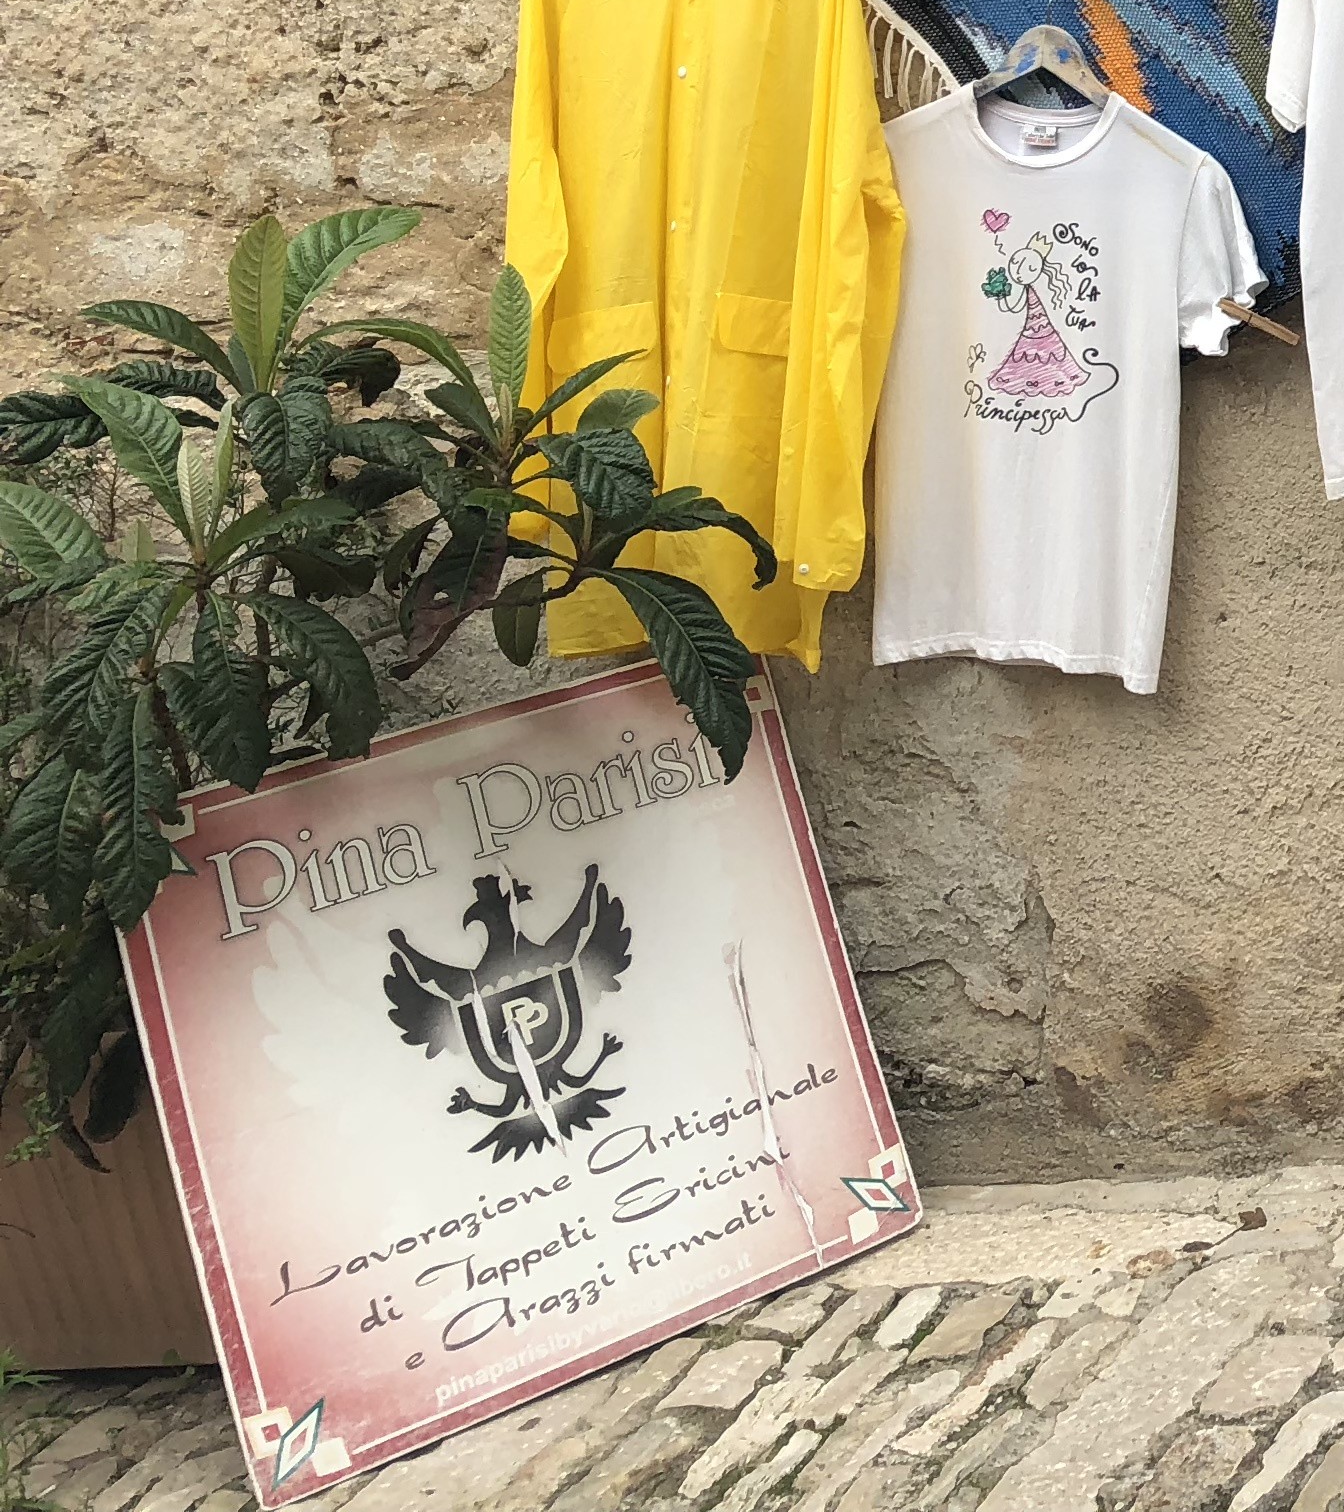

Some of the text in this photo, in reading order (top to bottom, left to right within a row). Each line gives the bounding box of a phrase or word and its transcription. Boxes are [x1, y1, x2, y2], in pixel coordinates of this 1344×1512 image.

[207, 711, 720, 942] Pina Parisi
[271, 1062, 839, 1306] Lavorazione Artigianale
[359, 1145, 791, 1335] di Tappeti Ericini
[404, 1196, 777, 1372] e Arazzi firmati
